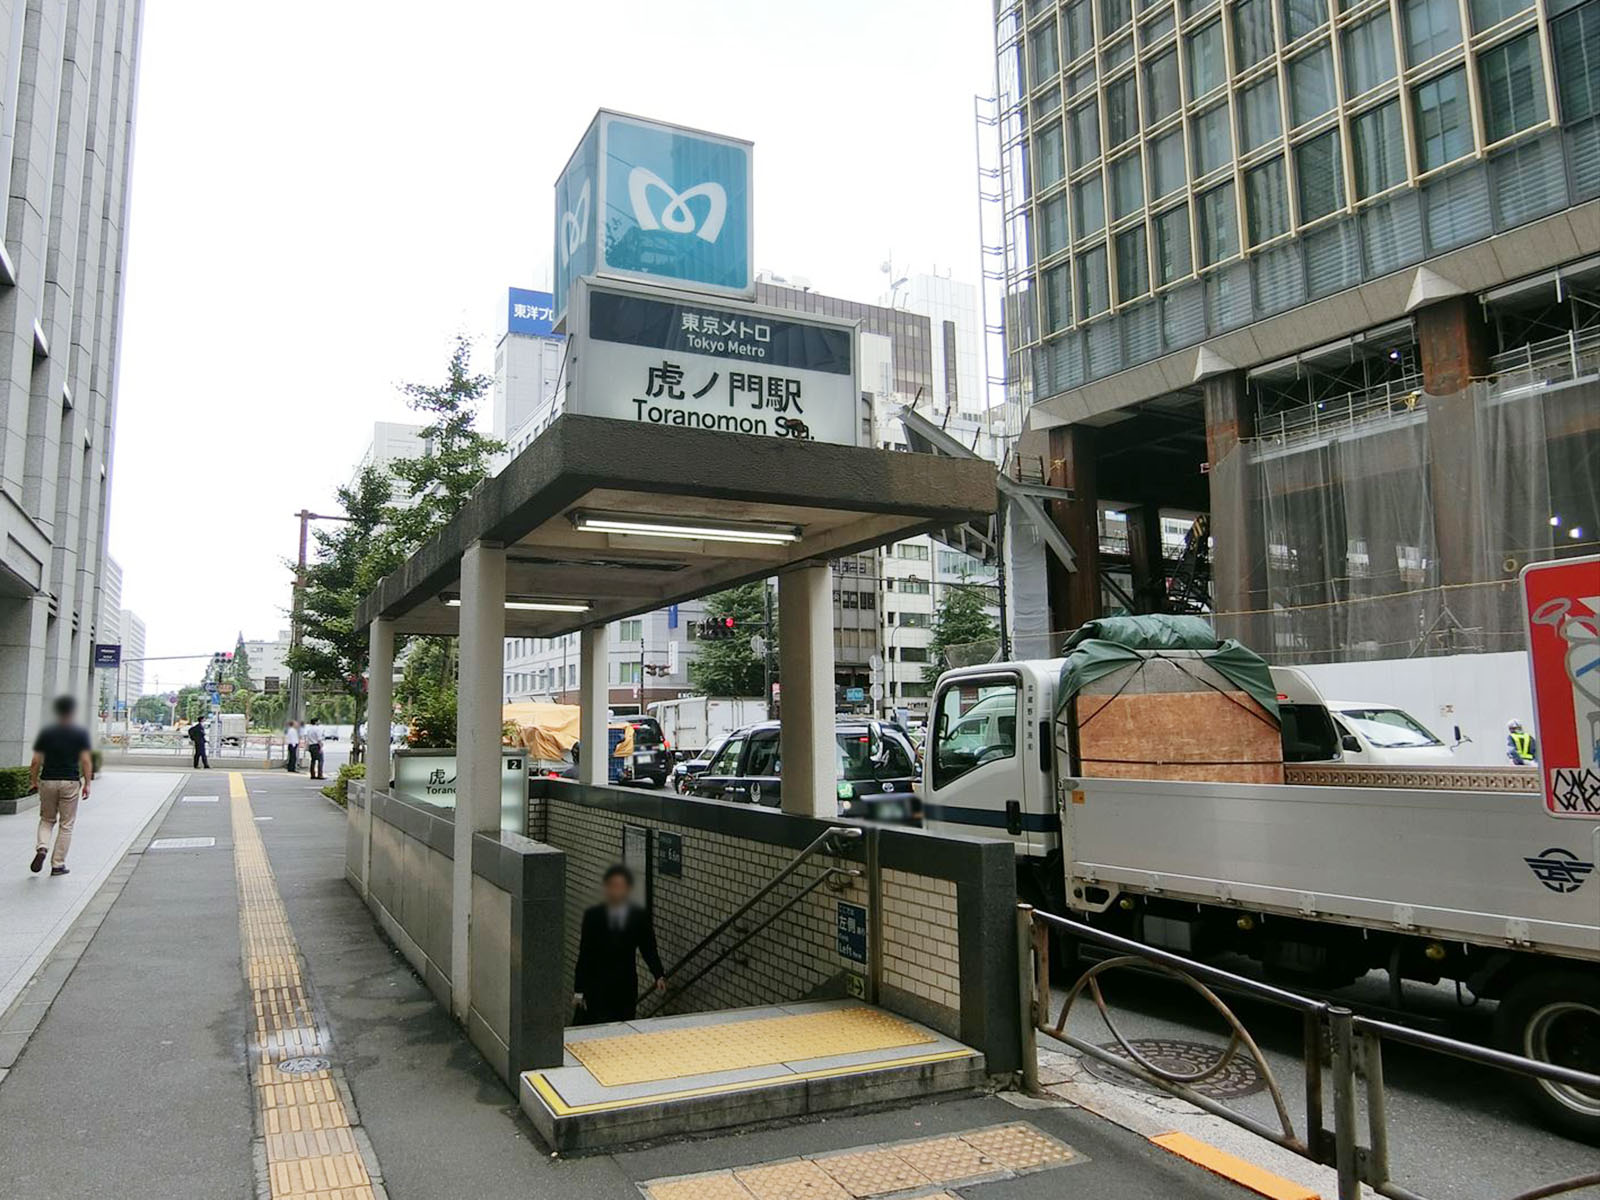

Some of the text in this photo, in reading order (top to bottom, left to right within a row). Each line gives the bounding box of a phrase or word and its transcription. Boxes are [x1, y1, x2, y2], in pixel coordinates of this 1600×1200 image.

[681, 312, 771, 343] 東京メトロ
[687, 334, 765, 358] Tokyo Metro
[645, 361, 803, 414] 虎ノ門駅
[632, 399, 767, 435] Toranomon
[511, 760, 518, 769] 2
